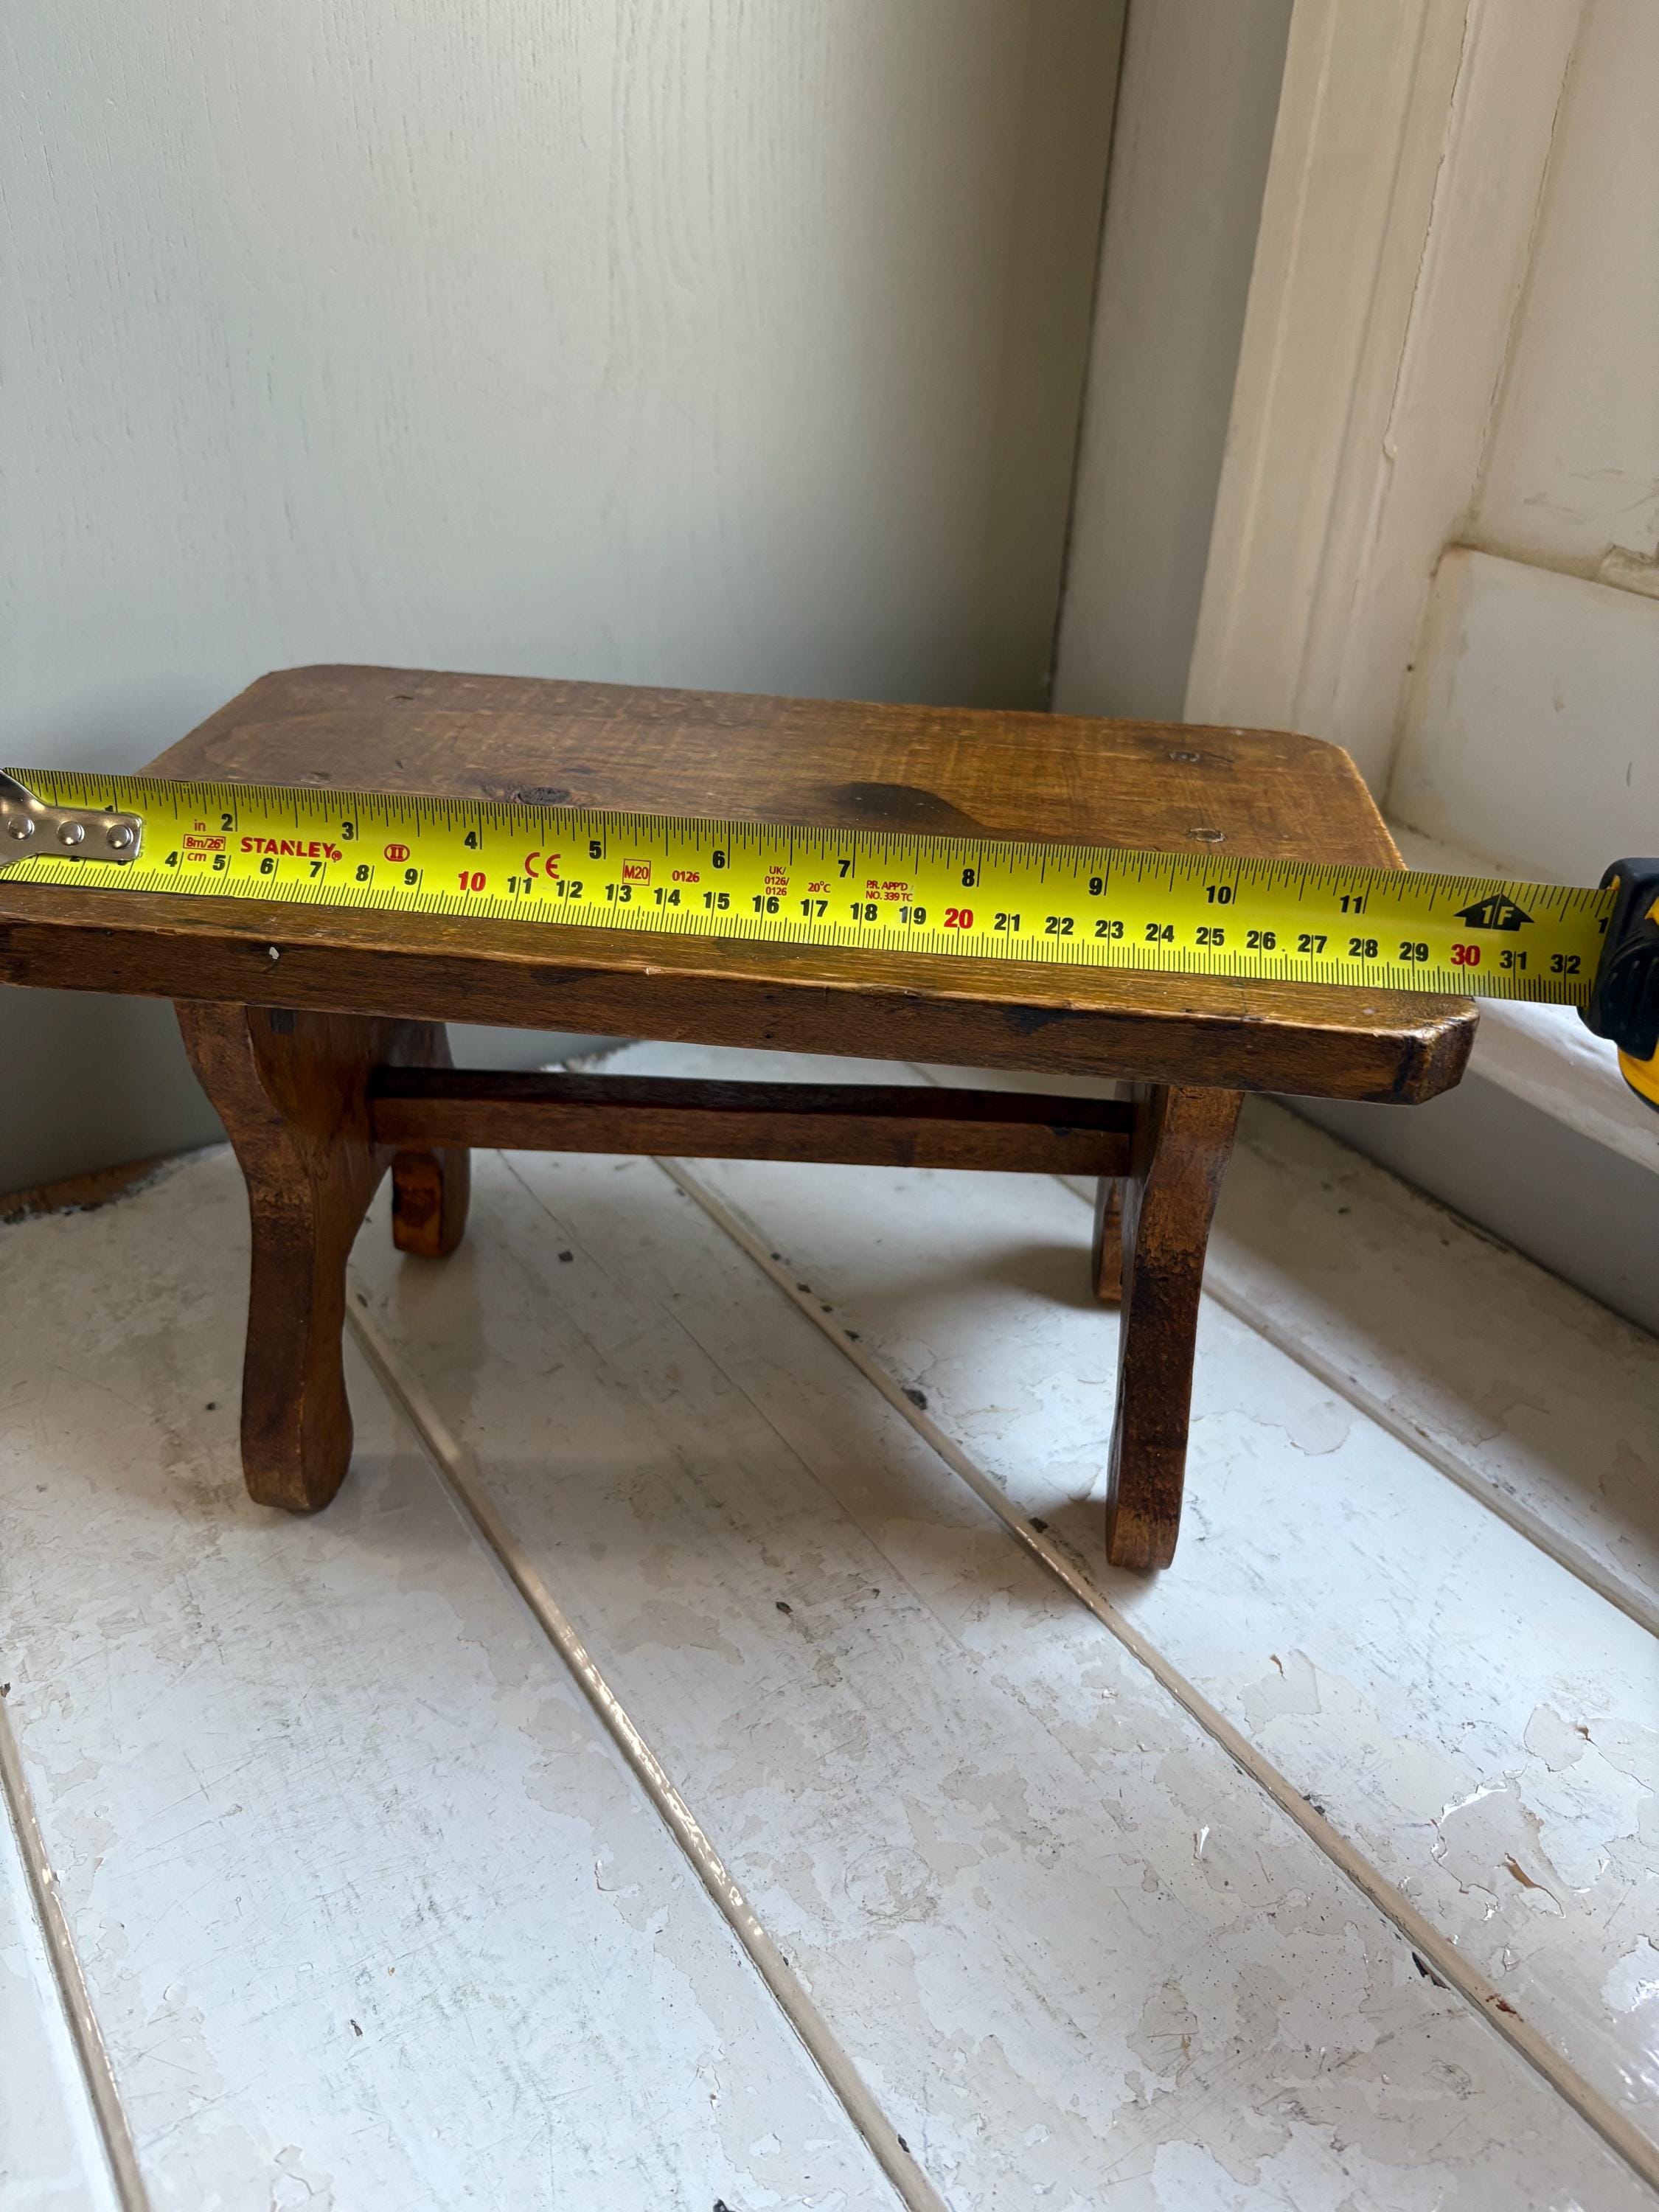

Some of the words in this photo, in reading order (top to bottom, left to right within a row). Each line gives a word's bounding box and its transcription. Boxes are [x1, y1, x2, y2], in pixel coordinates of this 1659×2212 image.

[194, 819, 206, 832] in
[187, 852, 207, 862] cm
[221, 813, 234, 832] 2
[341, 822, 354, 841] 3
[464, 831, 478, 849] 4
[589, 841, 602, 860] 5
[712, 850, 726, 869] 6
[838, 860, 851, 878] 7
[961, 869, 975, 887] 8
[1088, 877, 1102, 896] 9
[1206, 886, 1231, 905] 10
[1339, 895, 1363, 914] 11
[624, 865, 649, 880] M20
[672, 870, 700, 883] 0126
[769, 866, 787, 875] UK/
[764, 875, 790, 886] 0126/
[765, 886, 787, 897] 0126
[883, 892, 900, 902] 339
[902, 893, 913, 902] TC
[164, 852, 178, 867] 4
[212, 855, 226, 871] 5
[260, 858, 274, 874] 6
[310, 861, 323, 877] 7
[355, 864, 369, 882] 8
[404, 869, 418, 886] 9
[458, 871, 487, 891] 10
[507, 876, 532, 894] 11
[556, 880, 583, 898] 12
[605, 883, 632, 902] 13
[654, 887, 681, 906] 14
[703, 891, 730, 910] 15
[752, 895, 779, 914] 16
[800, 899, 829, 917] 17
[850, 902, 878, 921] 18
[899, 905, 927, 925] 19
[943, 908, 974, 929] 20
[993, 913, 1020, 931] 21
[1044, 916, 1074, 935] 22
[1094, 919, 1124, 939] 23
[1145, 923, 1175, 942] 24
[1195, 927, 1225, 946] 25
[1246, 930, 1276, 950] 26
[1297, 933, 1327, 953] 27
[1349, 938, 1378, 958] 28
[1399, 942, 1429, 961] 29
[1450, 943, 1481, 967] 30
[1499, 950, 1528, 970] 31
[1550, 953, 1582, 975] 32
[1482, 905, 1514, 925] 1F
